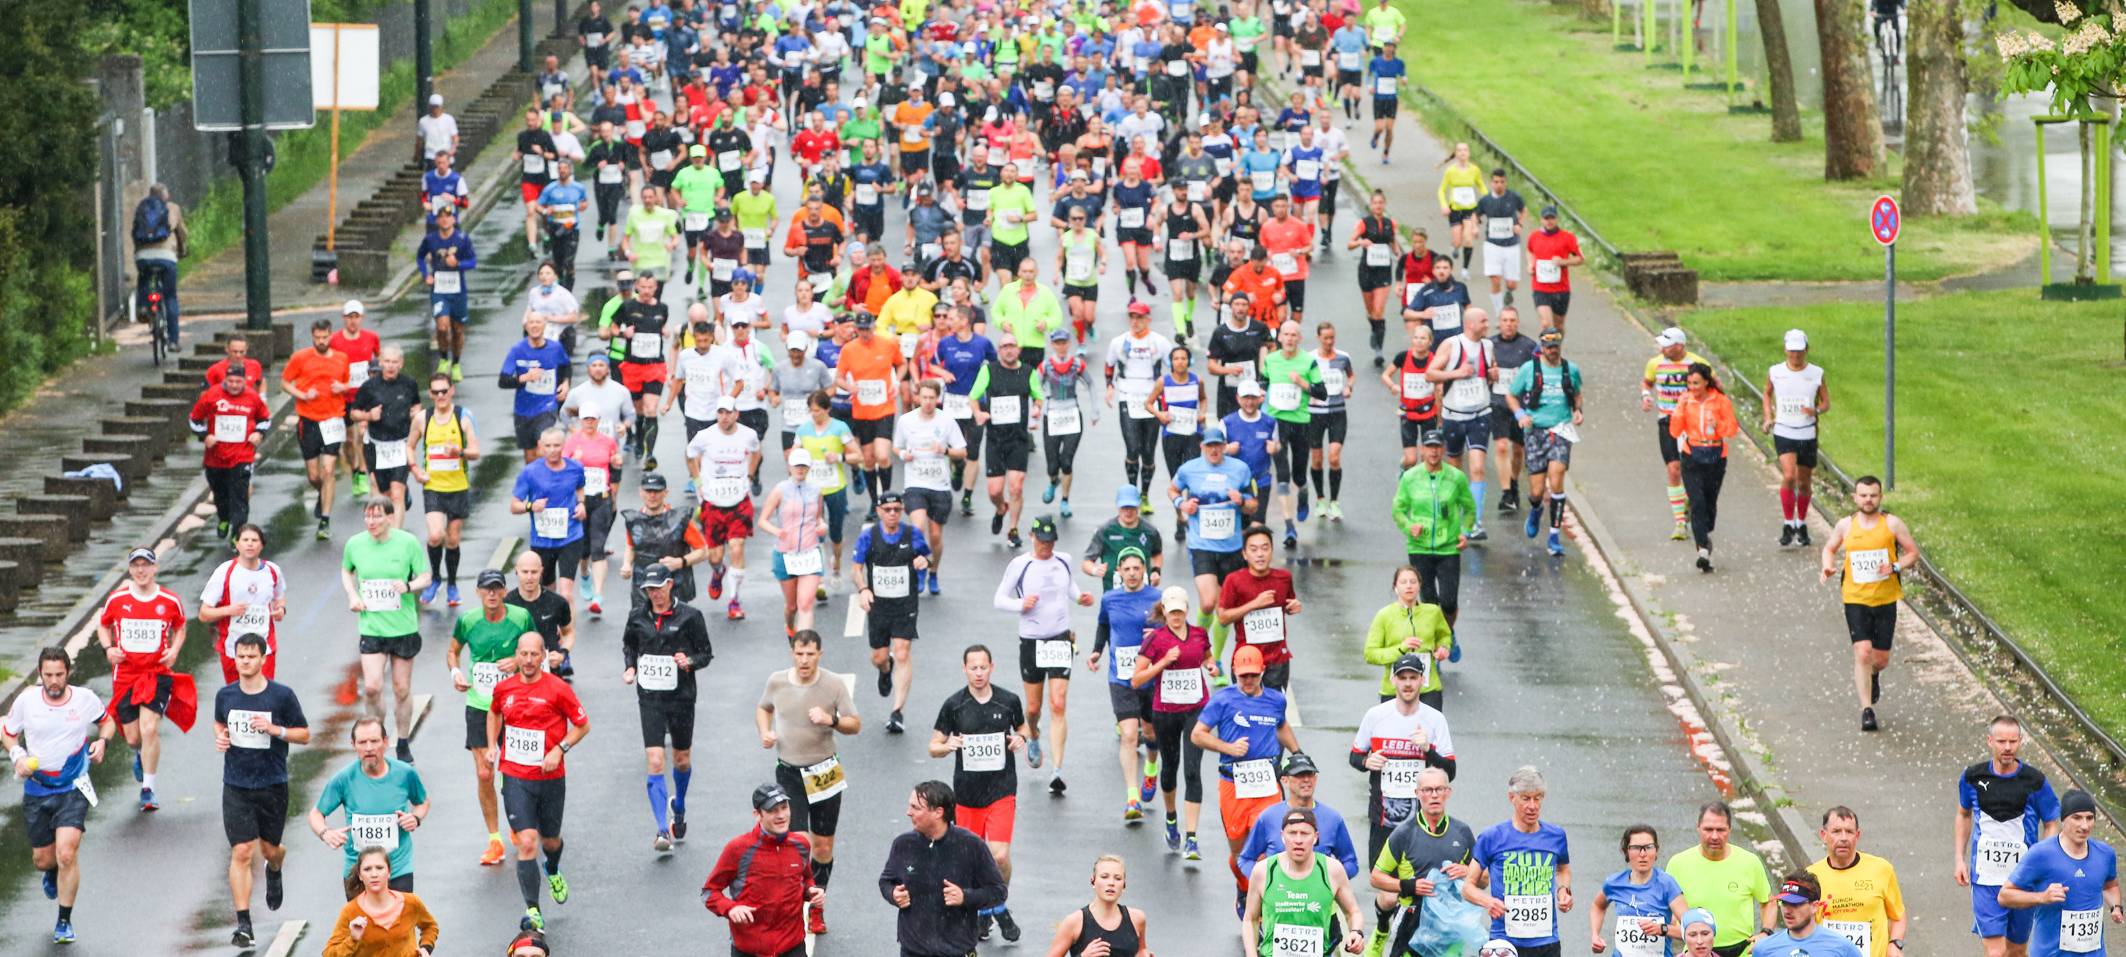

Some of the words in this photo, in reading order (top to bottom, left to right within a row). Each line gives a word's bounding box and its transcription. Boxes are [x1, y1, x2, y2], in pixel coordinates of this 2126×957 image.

[1203, 518, 1231, 528] 3407
[877, 576, 904, 586] 2684
[366, 588, 396, 600] 3166
[1249, 617, 1280, 631] 3804
[126, 629, 157, 641] 3583
[643, 665, 672, 678] 2512
[1166, 679, 1198, 692] 3828
[968, 734, 999, 742] METRO
[509, 737, 539, 752] 2188
[967, 744, 1001, 757] 3306
[812, 769, 836, 788] 222
[1239, 770, 1272, 784] 3393
[357, 815, 393, 824] METRO
[357, 826, 392, 840] 1881
[1985, 840, 2021, 849] METRO
[1984, 849, 2020, 864] 1371
[1286, 890, 1309, 900] Team
[1512, 896, 1548, 905] METRO
[1832, 901, 1865, 909] MARATHON
[1511, 906, 1548, 922] 2985
[2070, 911, 2100, 920] METRO
[1281, 927, 1318, 937] METRO
[1827, 922, 1864, 931] METRO
[2068, 920, 2100, 937] 1335
[1279, 937, 1317, 954] 3621
